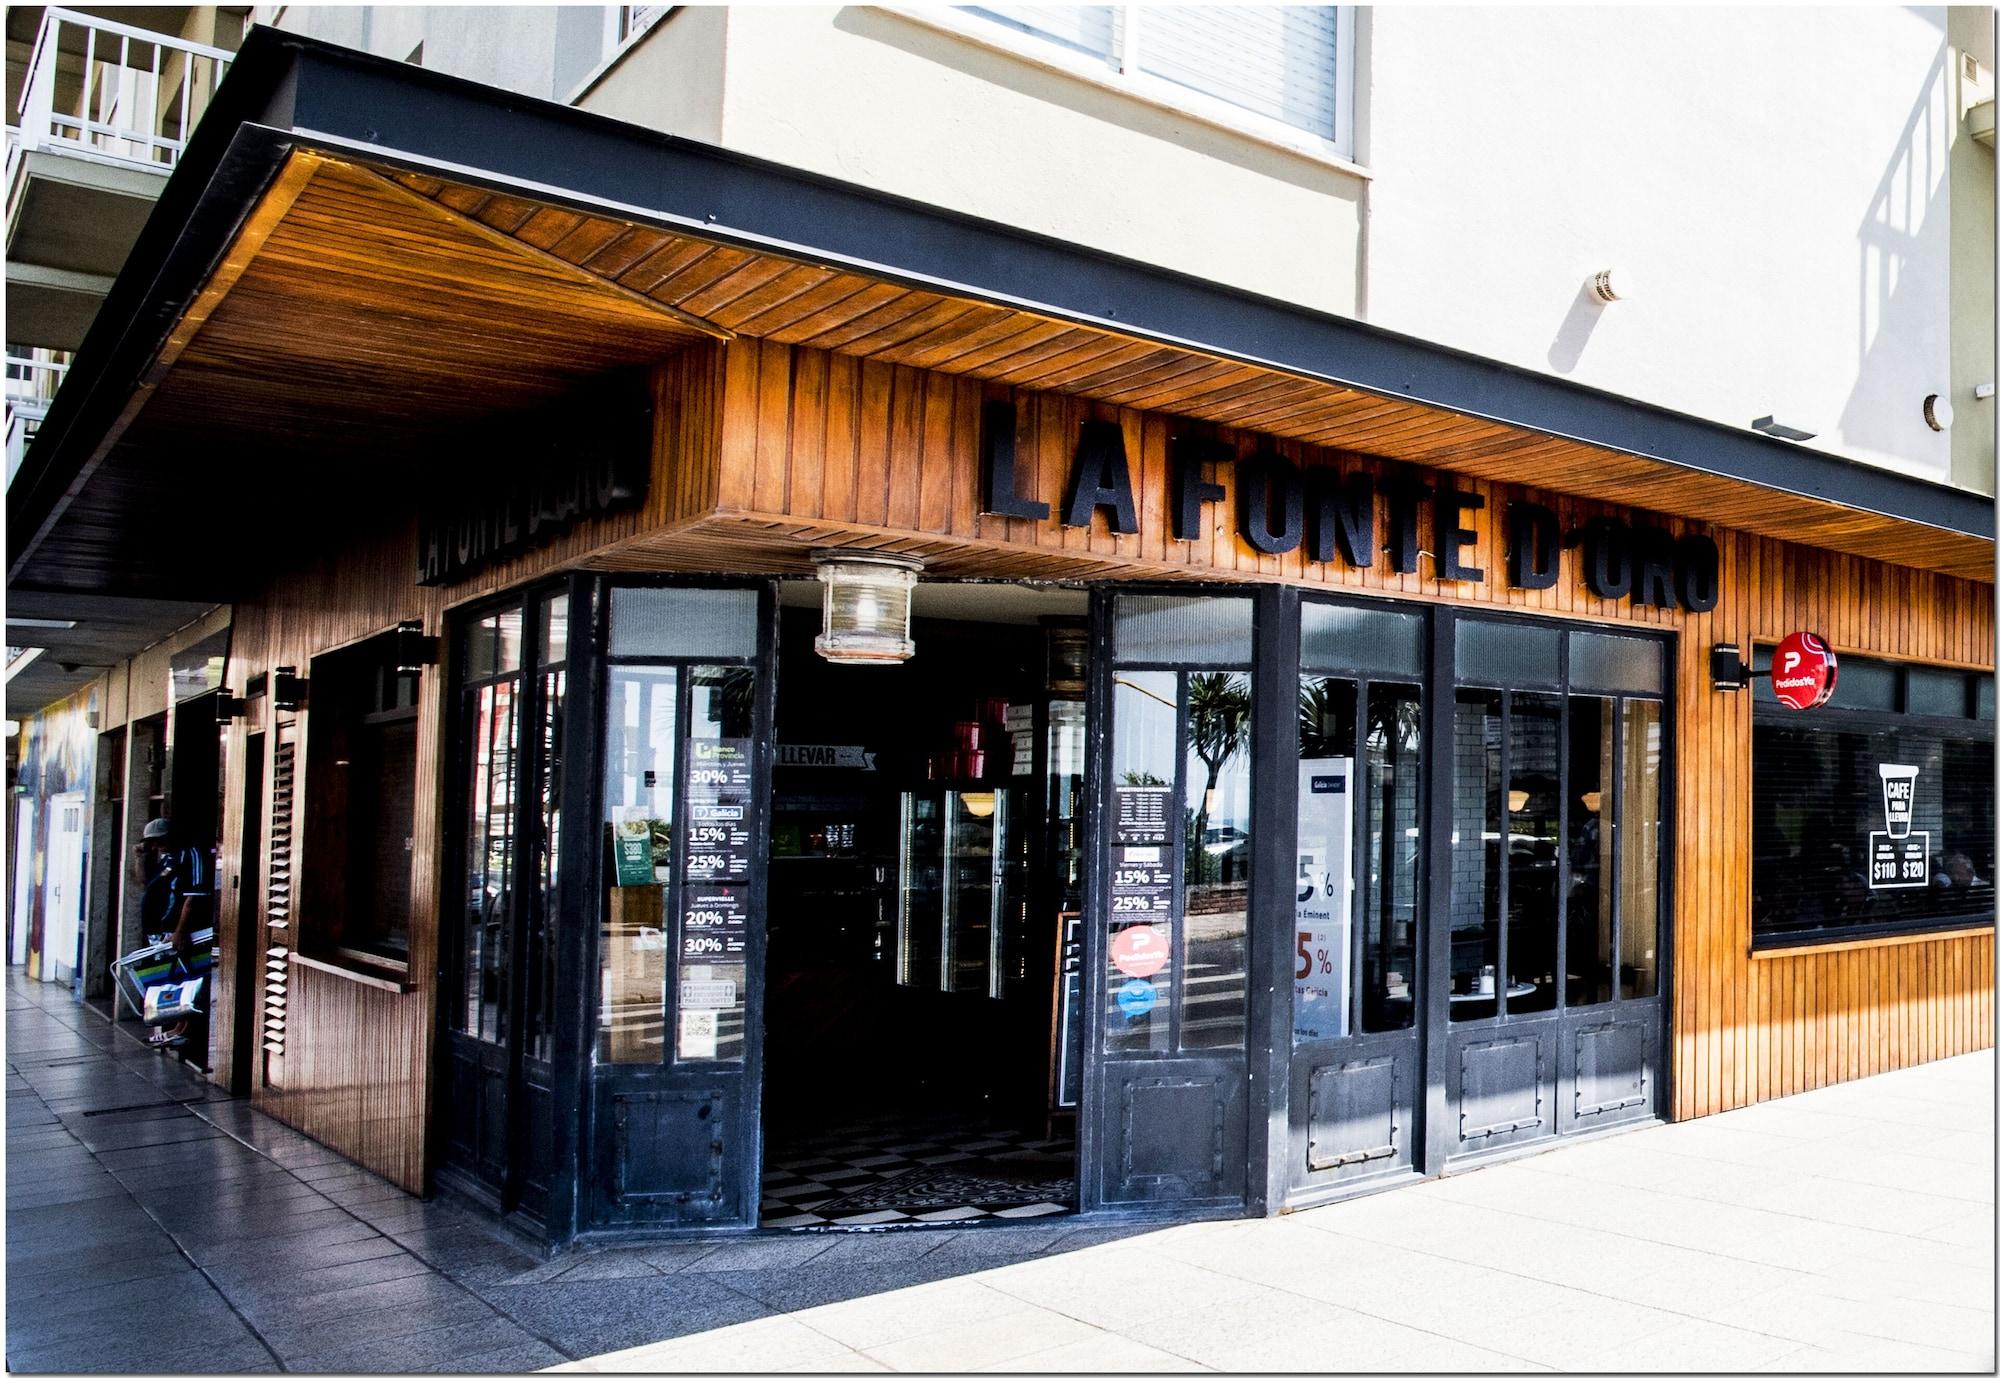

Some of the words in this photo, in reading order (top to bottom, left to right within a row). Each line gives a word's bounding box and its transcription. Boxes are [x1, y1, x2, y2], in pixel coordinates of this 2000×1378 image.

[979, 402, 1138, 534] LA
[1171, 436, 1485, 583] FONTE
[1507, 501, 1719, 613] D'ORO
[1775, 676, 1816, 689] PedidosYa
[781, 746, 836, 765] LLEVAR
[691, 769, 728, 784] 30%
[1887, 782, 1910, 799] CAFE
[710, 808, 739, 817] Galicia
[689, 827, 726, 841] 15%
[687, 855, 725, 869] 25%
[1114, 869, 1150, 884] 15%
[1874, 862, 1896, 880] $110
[1902, 861, 1924, 879] $120
[1113, 896, 1150, 911] 25%
[685, 911, 723, 925] 20%
[684, 938, 722, 952] 30%
